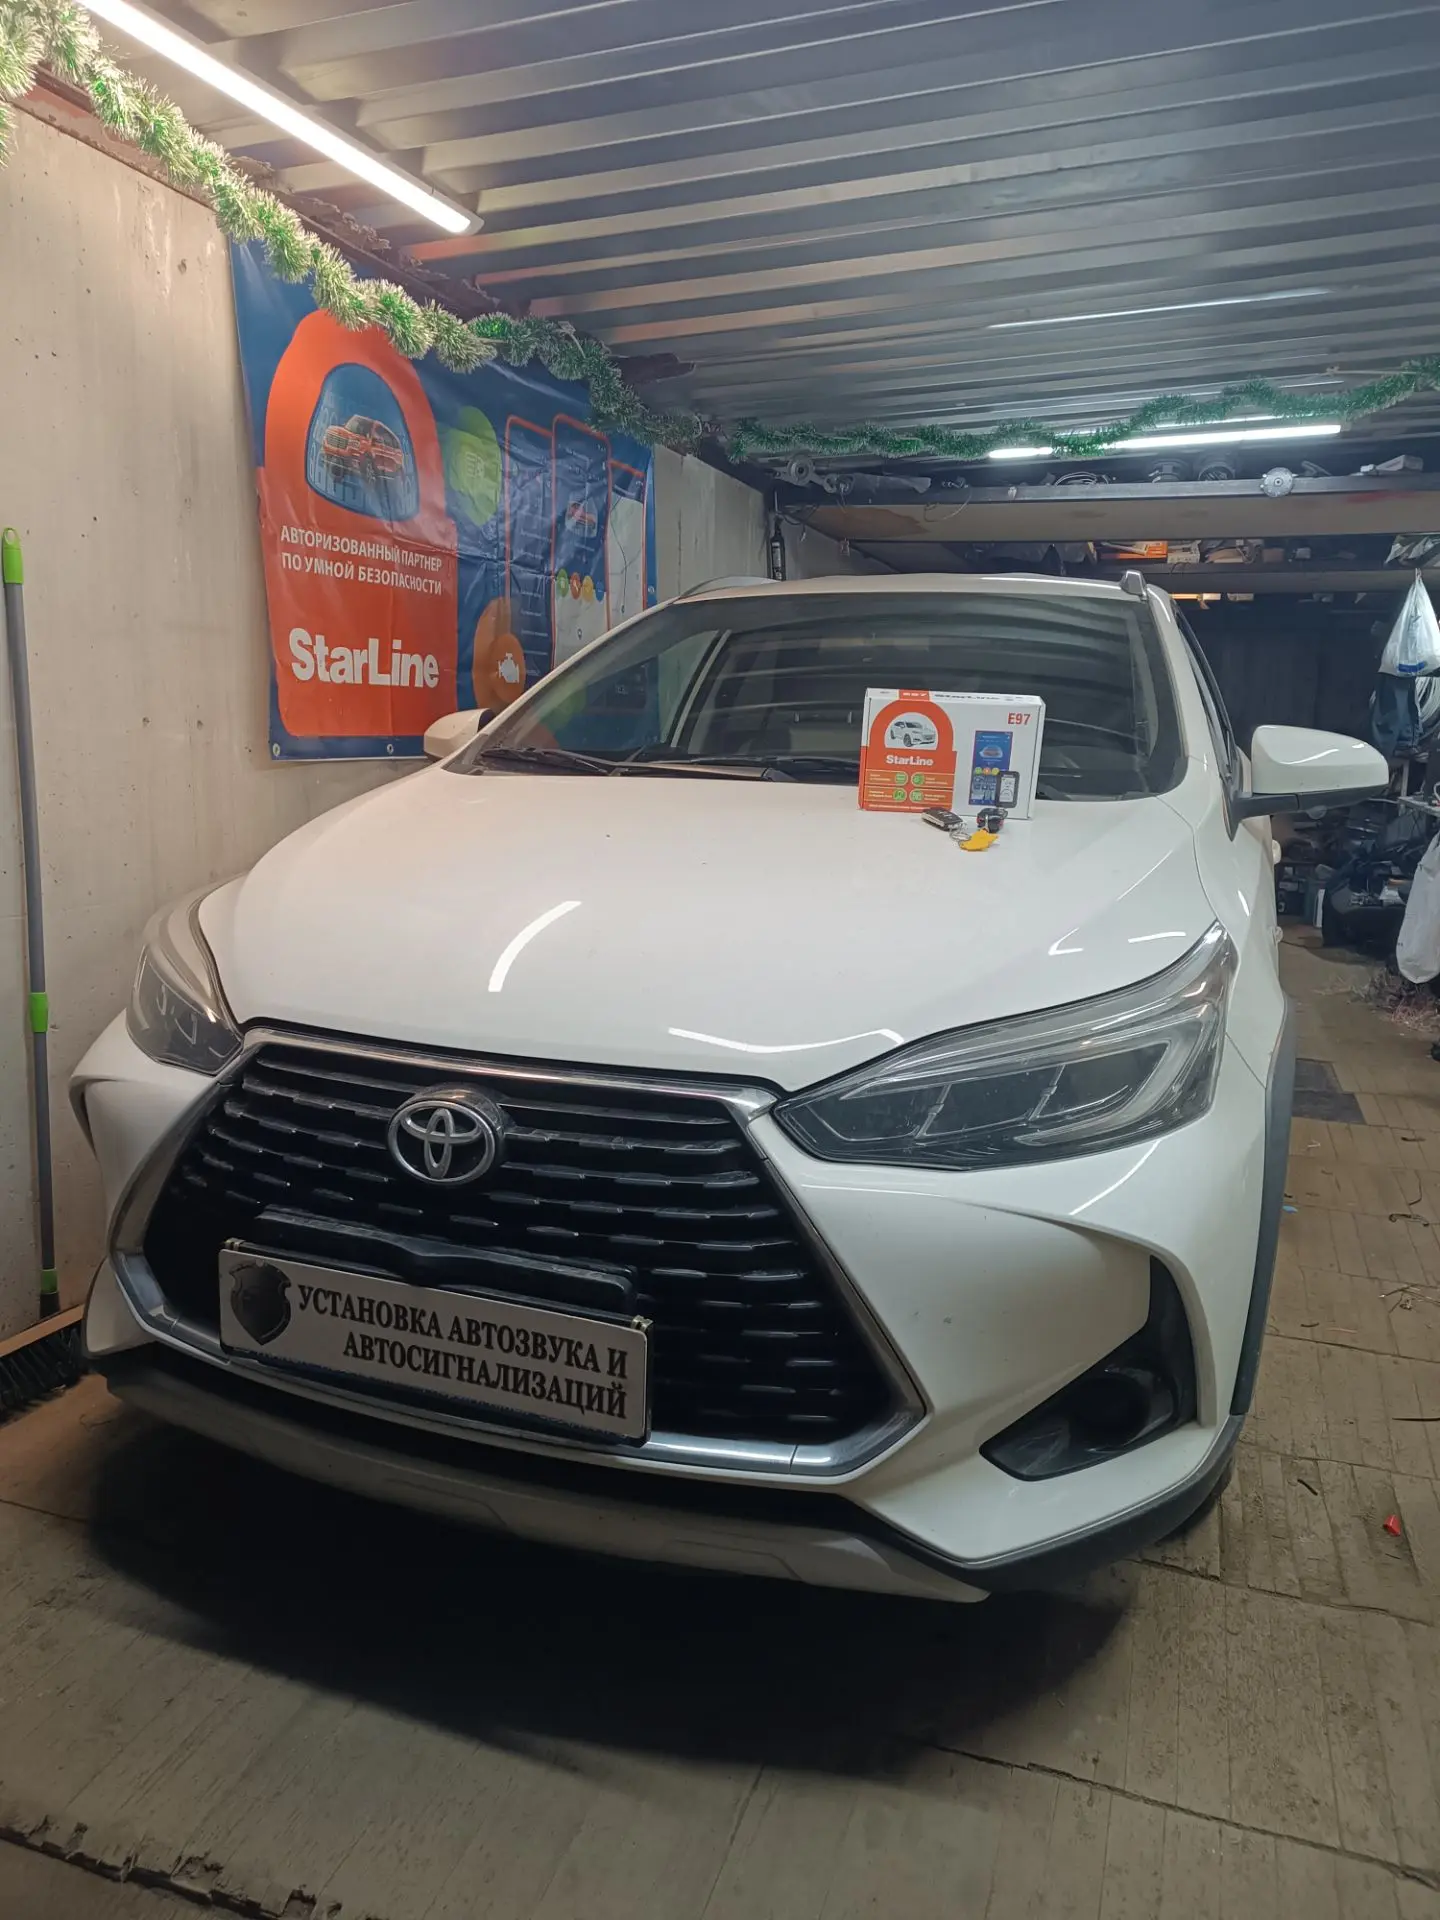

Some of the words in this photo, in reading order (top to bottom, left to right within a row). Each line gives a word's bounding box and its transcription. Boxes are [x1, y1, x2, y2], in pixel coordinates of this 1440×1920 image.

[281, 525, 400, 563] АВТОРИЗОВАННЫЙ
[402, 550, 442, 572] ПАРТНЕР
[281, 552, 302, 570] ПО
[305, 555, 354, 579] УМНОЙ
[358, 565, 442, 595] БЕЗОПАСНОСТИ
[289, 628, 439, 688] StarLine
[1007, 712, 1031, 726] E97
[886, 754, 934, 767] StarLine
[297, 1284, 443, 1340] УСТАНОВКА
[448, 1316, 600, 1373] АВТОЗВУКА
[606, 1347, 628, 1379] И
[343, 1332, 627, 1419] АВТОСИГНАЛИЗАЦИЙ
